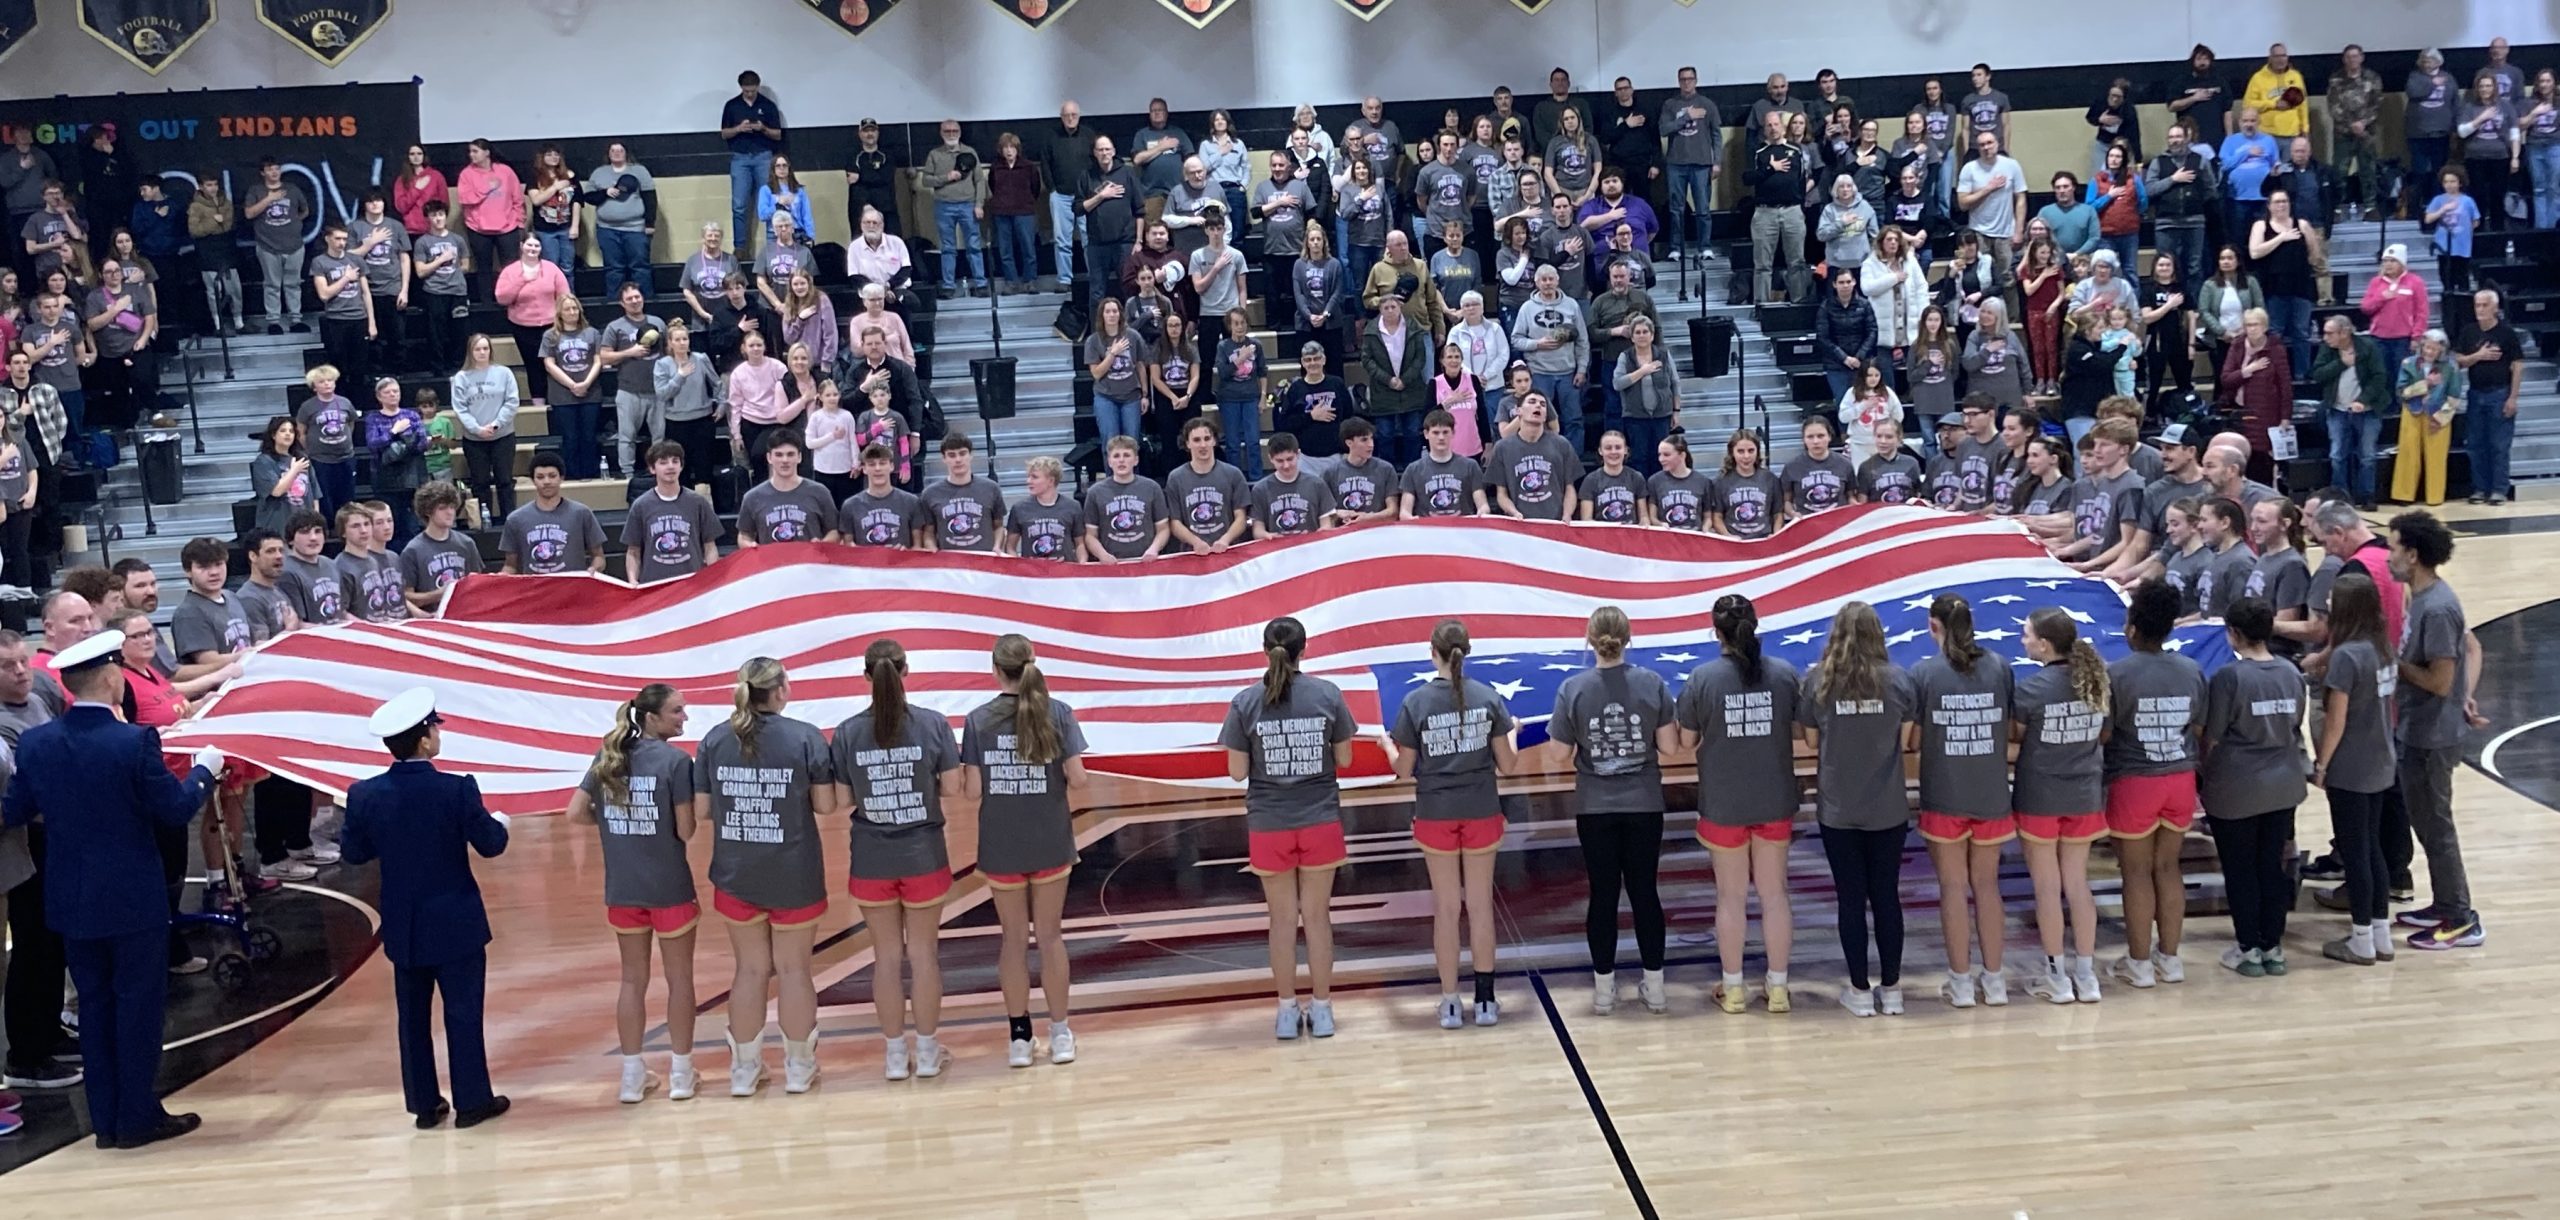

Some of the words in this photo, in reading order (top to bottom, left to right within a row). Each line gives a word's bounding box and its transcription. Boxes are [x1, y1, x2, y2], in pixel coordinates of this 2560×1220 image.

[116, 16, 183, 35] FOOTBALL
[291, 9, 359, 27] FOOTBALL
[2, 123, 116, 144] LGHS
[139, 120, 199, 141] OUT
[219, 116, 357, 137] INDIANS
[1725, 694, 1744, 709] SALLY
[1256, 720, 1280, 736] CHRIS
[1428, 712, 1460, 729] GRANDMA
[1726, 724, 1744, 738] PAUL
[1262, 735, 1286, 750] SHARI
[1287, 732, 1324, 747] WOOSTER
[1428, 740, 1456, 757] CANCER
[856, 749, 889, 766] GRANDPA
[890, 746, 922, 762] SHEPARD
[984, 750, 1010, 765] MARCIA
[1264, 748, 1290, 762] KAREN
[1292, 746, 1323, 761] FOWLER
[716, 766, 757, 782] GRANDMA
[758, 768, 794, 783] SHIRLEY
[868, 763, 898, 780] SHELLEY
[898, 762, 914, 776] FITZ
[1029, 765, 1046, 779] PAUL
[1266, 762, 1289, 776] CINDY
[1291, 760, 1323, 775] PIERSON
[722, 782, 762, 798] GRANDMA
[764, 784, 786, 798] JOAN
[990, 780, 1018, 794] SHELLEY
[864, 794, 899, 810] GRANDMA
[899, 792, 923, 808] NANCY
[726, 812, 740, 826] LEE
[742, 812, 780, 828] SIBLINGS
[721, 826, 742, 840] MIKE
